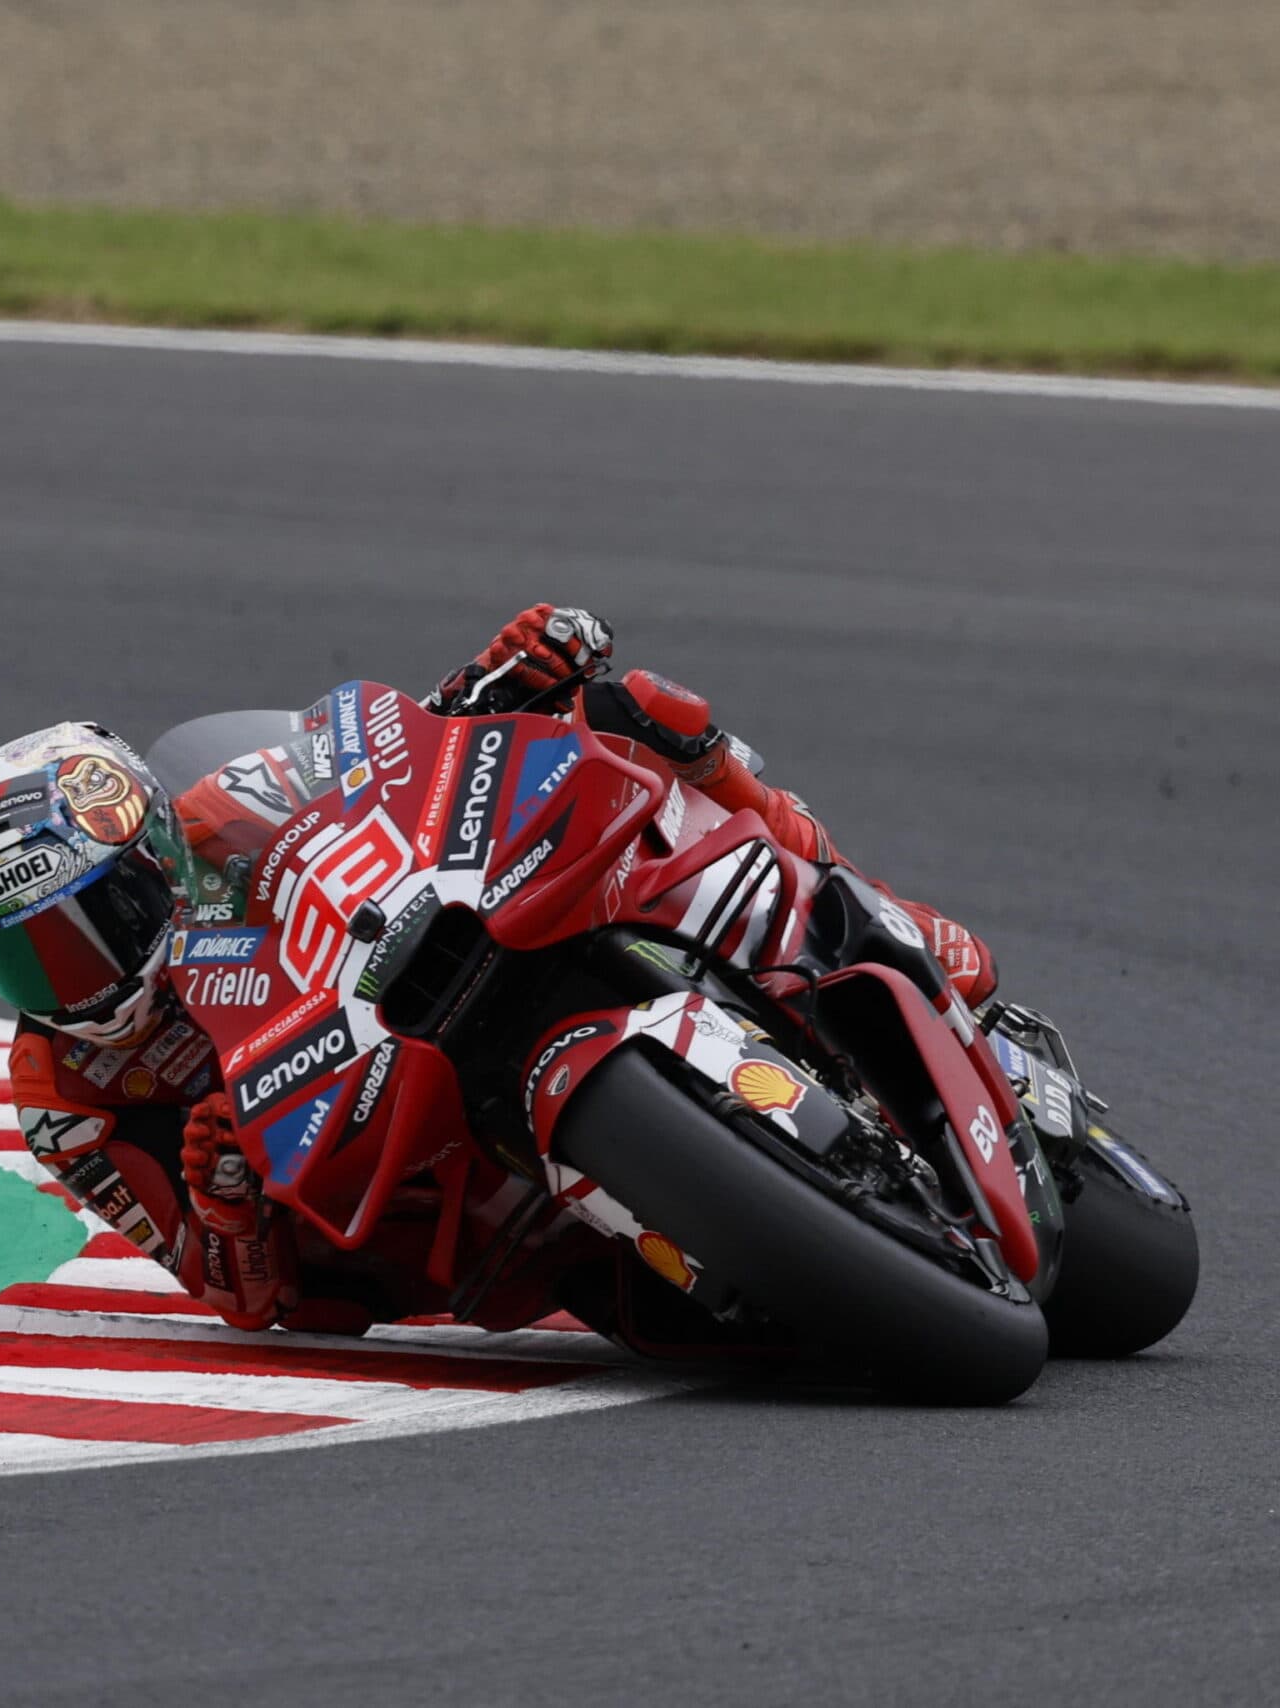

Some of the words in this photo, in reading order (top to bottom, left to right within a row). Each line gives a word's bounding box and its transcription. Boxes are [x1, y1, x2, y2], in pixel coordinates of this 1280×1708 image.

[337, 689, 361, 754] ADVANCE
[366, 690, 409, 770] riello
[426, 725, 461, 827] FRECCIAROSSA
[448, 730, 502, 861] Lenovo
[538, 750, 579, 793] TIM
[283, 812, 408, 988] 93
[482, 840, 552, 908] CARRERA
[196, 904, 234, 921] WRS
[368, 890, 435, 972] MONSTER
[188, 937, 256, 957] ADVANCE
[65, 983, 118, 1012] Insta360
[200, 968, 270, 1005] riello
[249, 991, 326, 1052] FRECCIAROSSA
[239, 1028, 345, 1112] Lenovo
[354, 1042, 395, 1122] CARRERA
[299, 1099, 330, 1148] TIM
[208, 1233, 225, 1287] Lenovo
